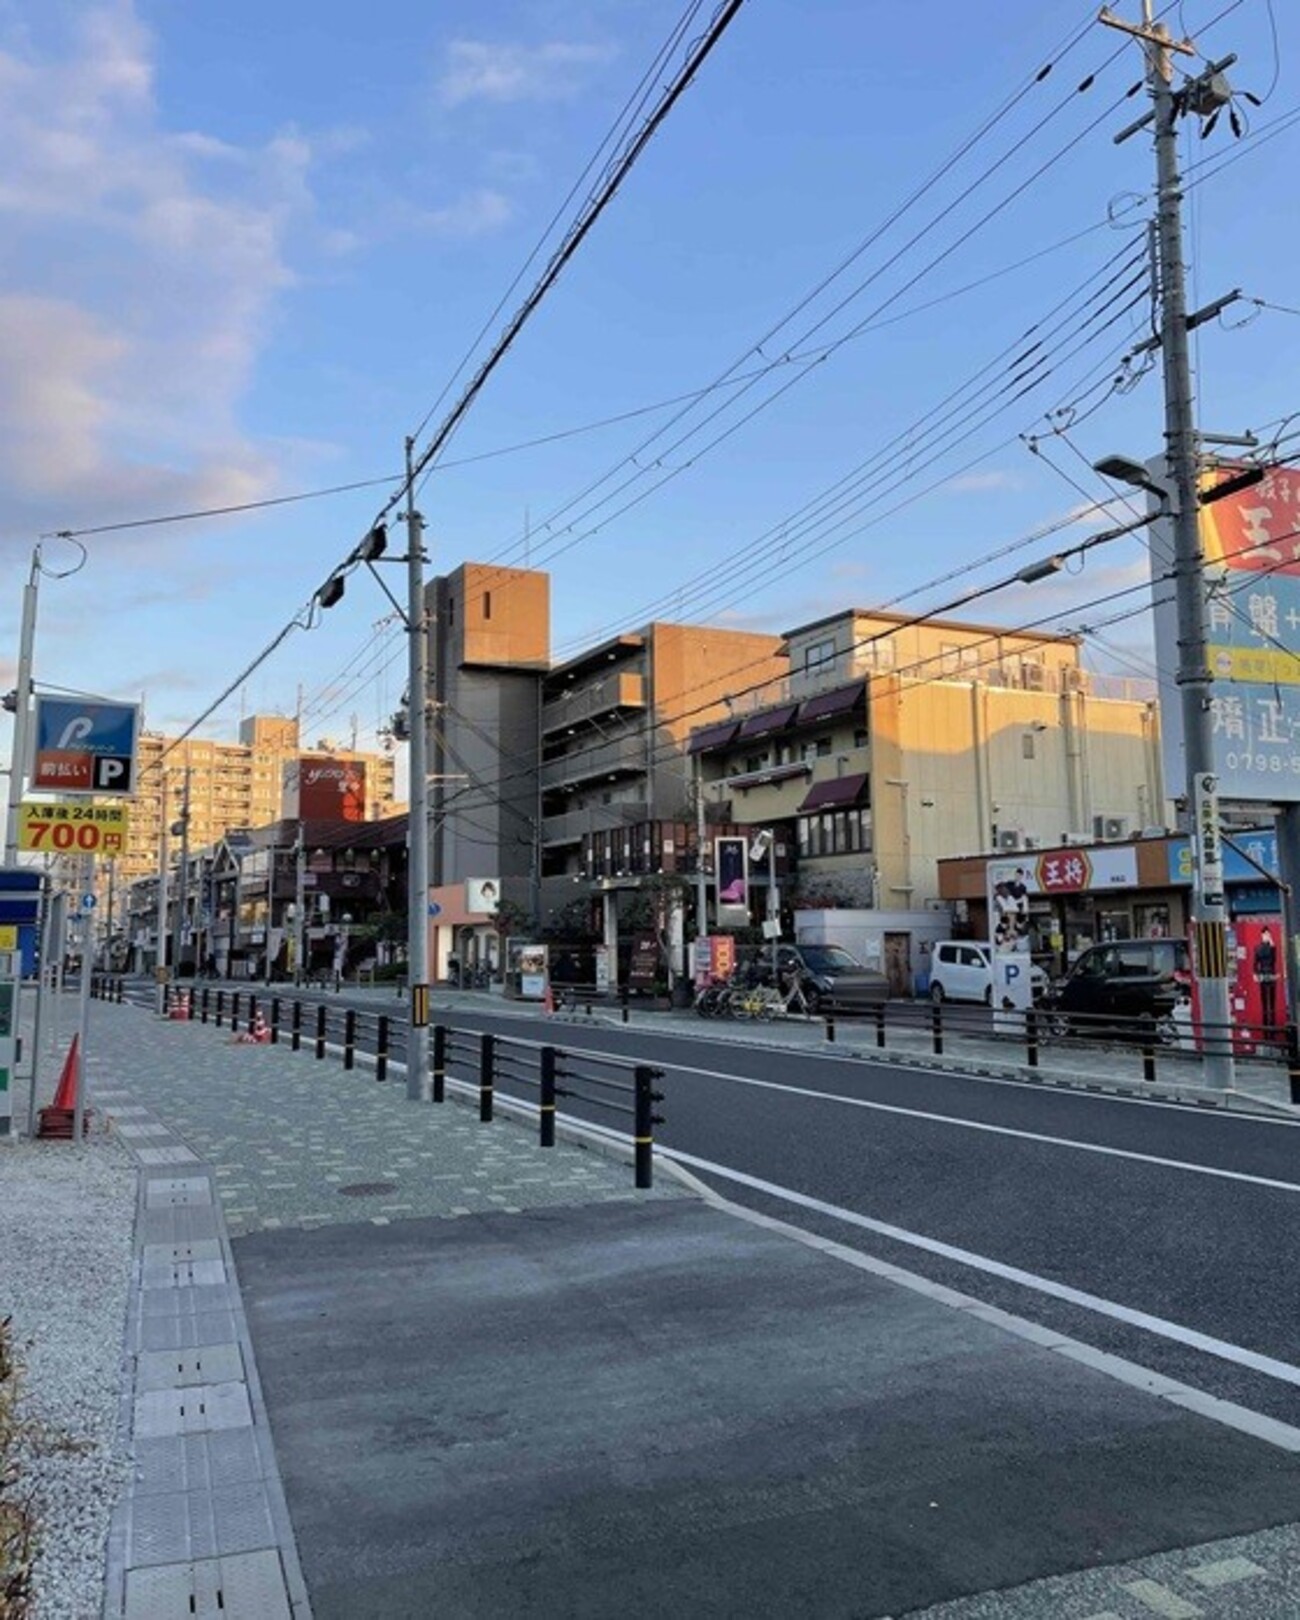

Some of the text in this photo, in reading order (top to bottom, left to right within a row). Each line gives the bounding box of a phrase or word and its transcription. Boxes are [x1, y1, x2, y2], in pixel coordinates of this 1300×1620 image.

[98, 758, 124, 787] P
[26, 822, 122, 851] 700円
[1045, 857, 1083, 886] 王将
[1004, 964, 1020, 986] P
